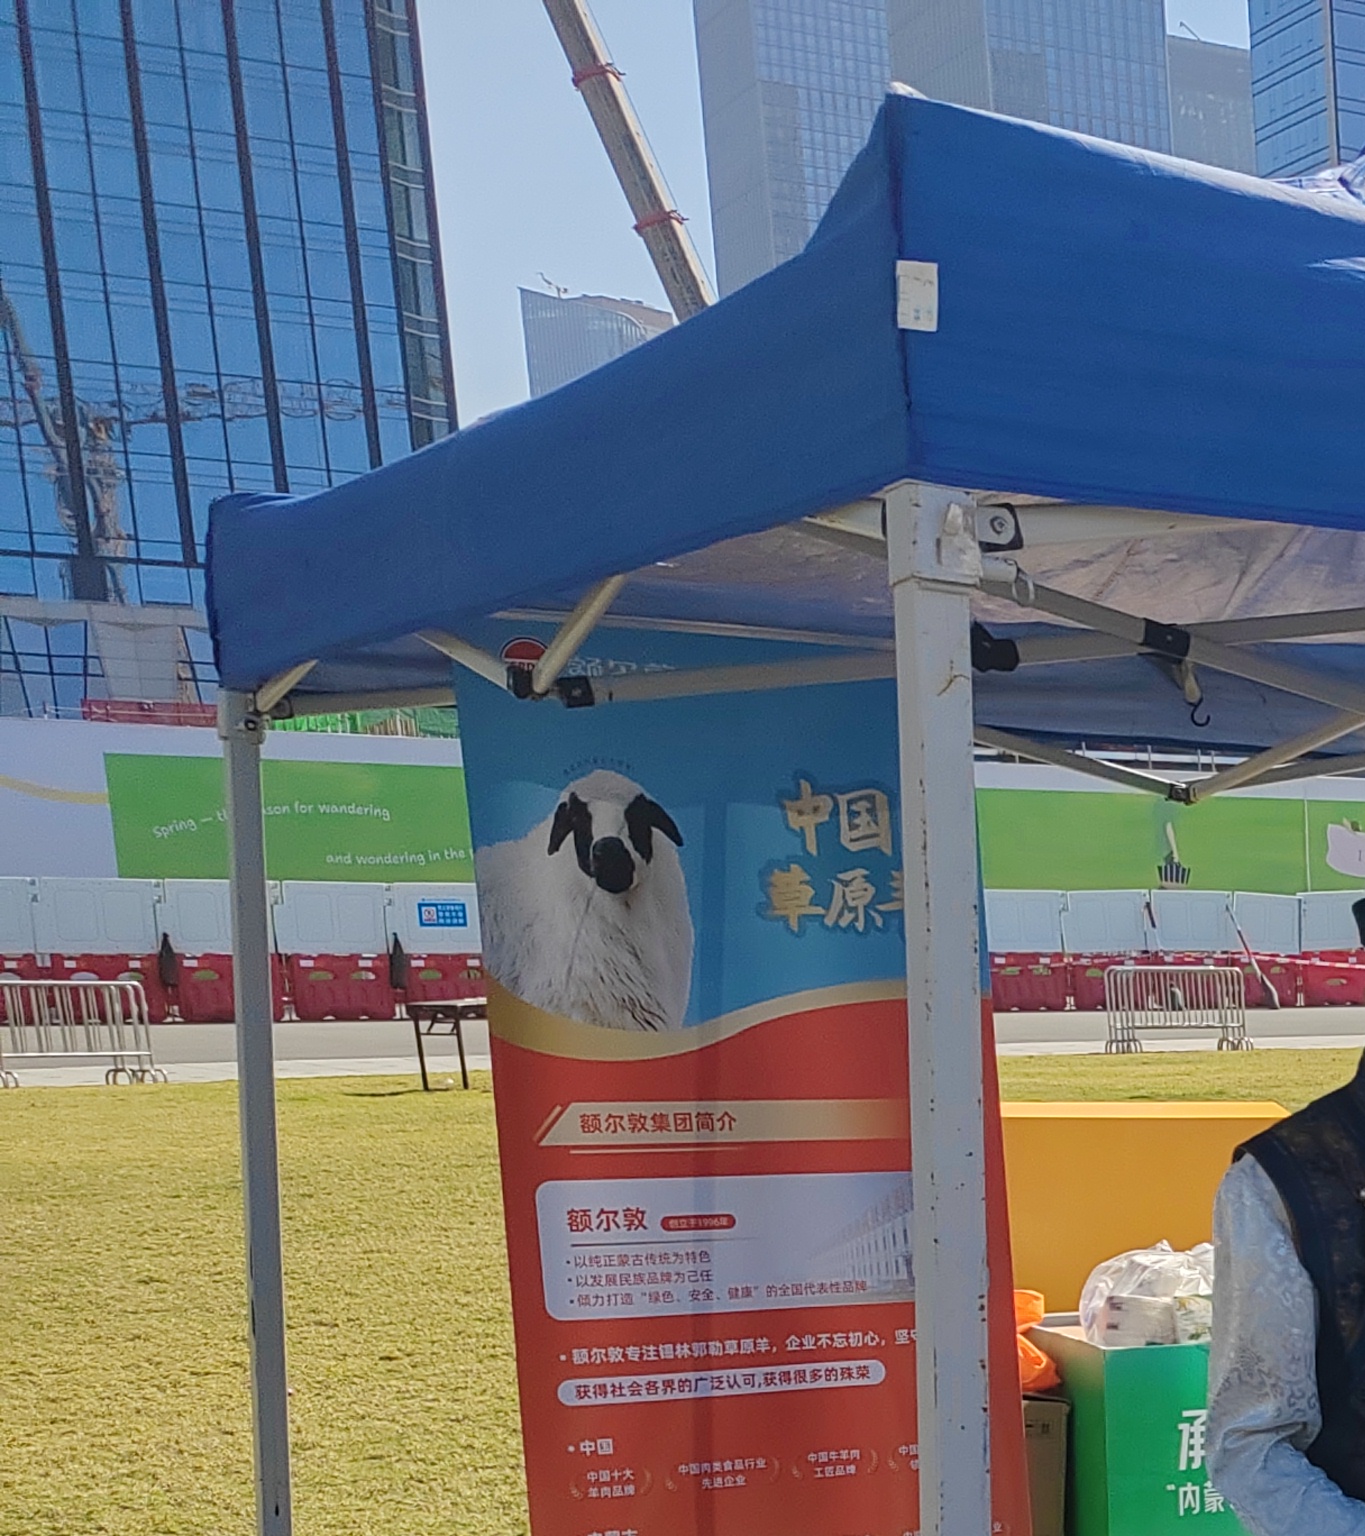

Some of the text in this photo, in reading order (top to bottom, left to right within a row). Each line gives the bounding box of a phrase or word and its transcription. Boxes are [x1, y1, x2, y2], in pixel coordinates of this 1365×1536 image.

[153, 817, 197, 840] Spring
[293, 801, 314, 815] for
[318, 802, 391, 821] wandering
[783, 779, 892, 857] 中国
[326, 847, 466, 866] and wondering in the
[579, 1110, 738, 1134] 额尔敦集团简介
[566, 1206, 649, 1233] 额尔敦
[573, 1250, 712, 1269] 以纯正蒙古传统为特色
[575, 1269, 714, 1288] 以发展民族品牌为己任
[579, 1438, 614, 1456] 中国
[586, 1467, 635, 1483] 中国十大
[677, 1457, 767, 1476] 中国肉类食品行业
[587, 1484, 636, 1499] 羊肉品牌
[701, 1475, 747, 1490] 先进企业
